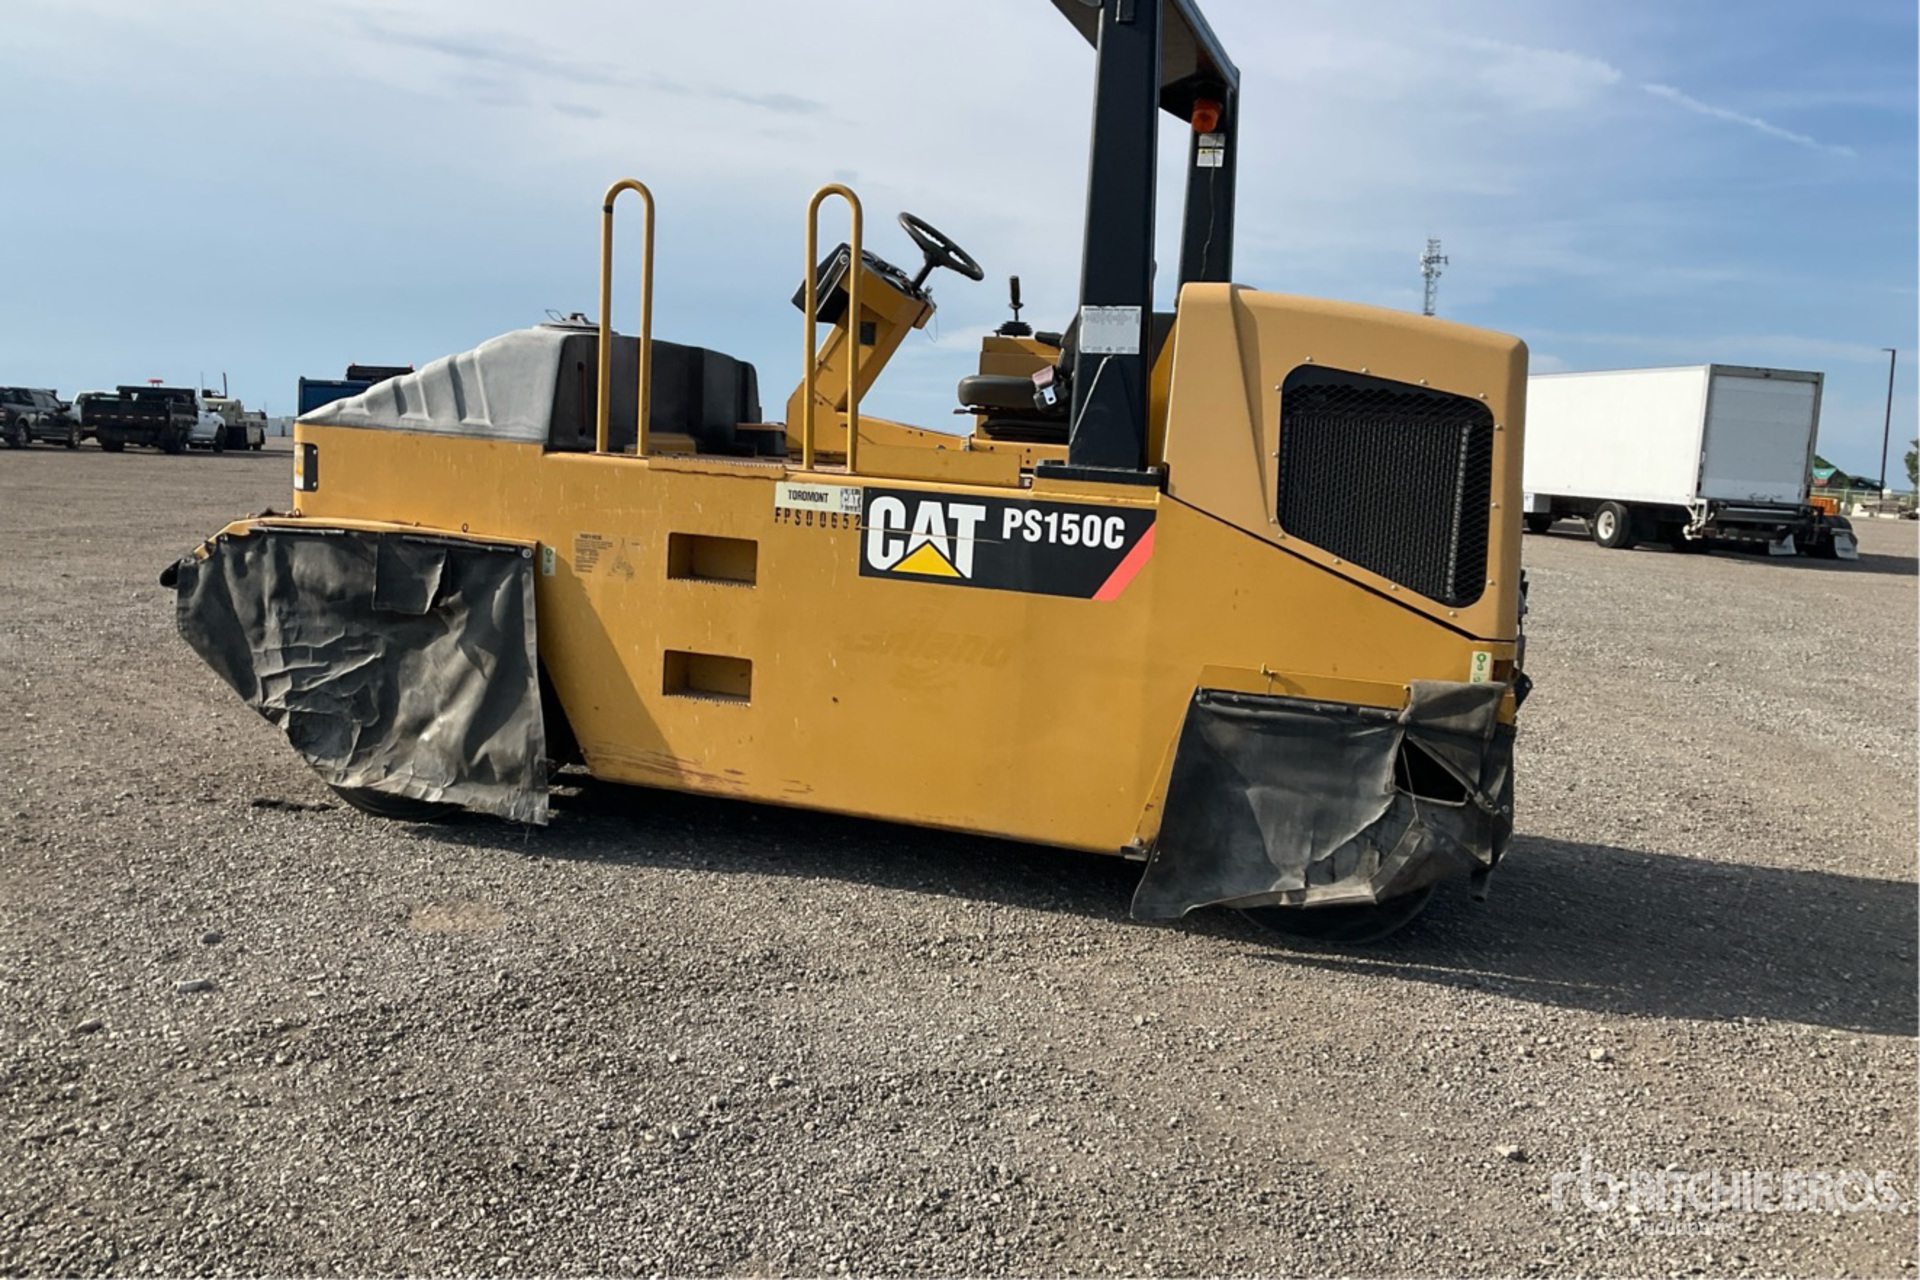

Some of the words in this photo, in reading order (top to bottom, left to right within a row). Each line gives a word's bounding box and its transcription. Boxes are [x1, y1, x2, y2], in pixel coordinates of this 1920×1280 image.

[788, 489, 830, 504] TOROMONT
[866, 496, 987, 580] CAT
[1002, 507, 1126, 551] PS150C
